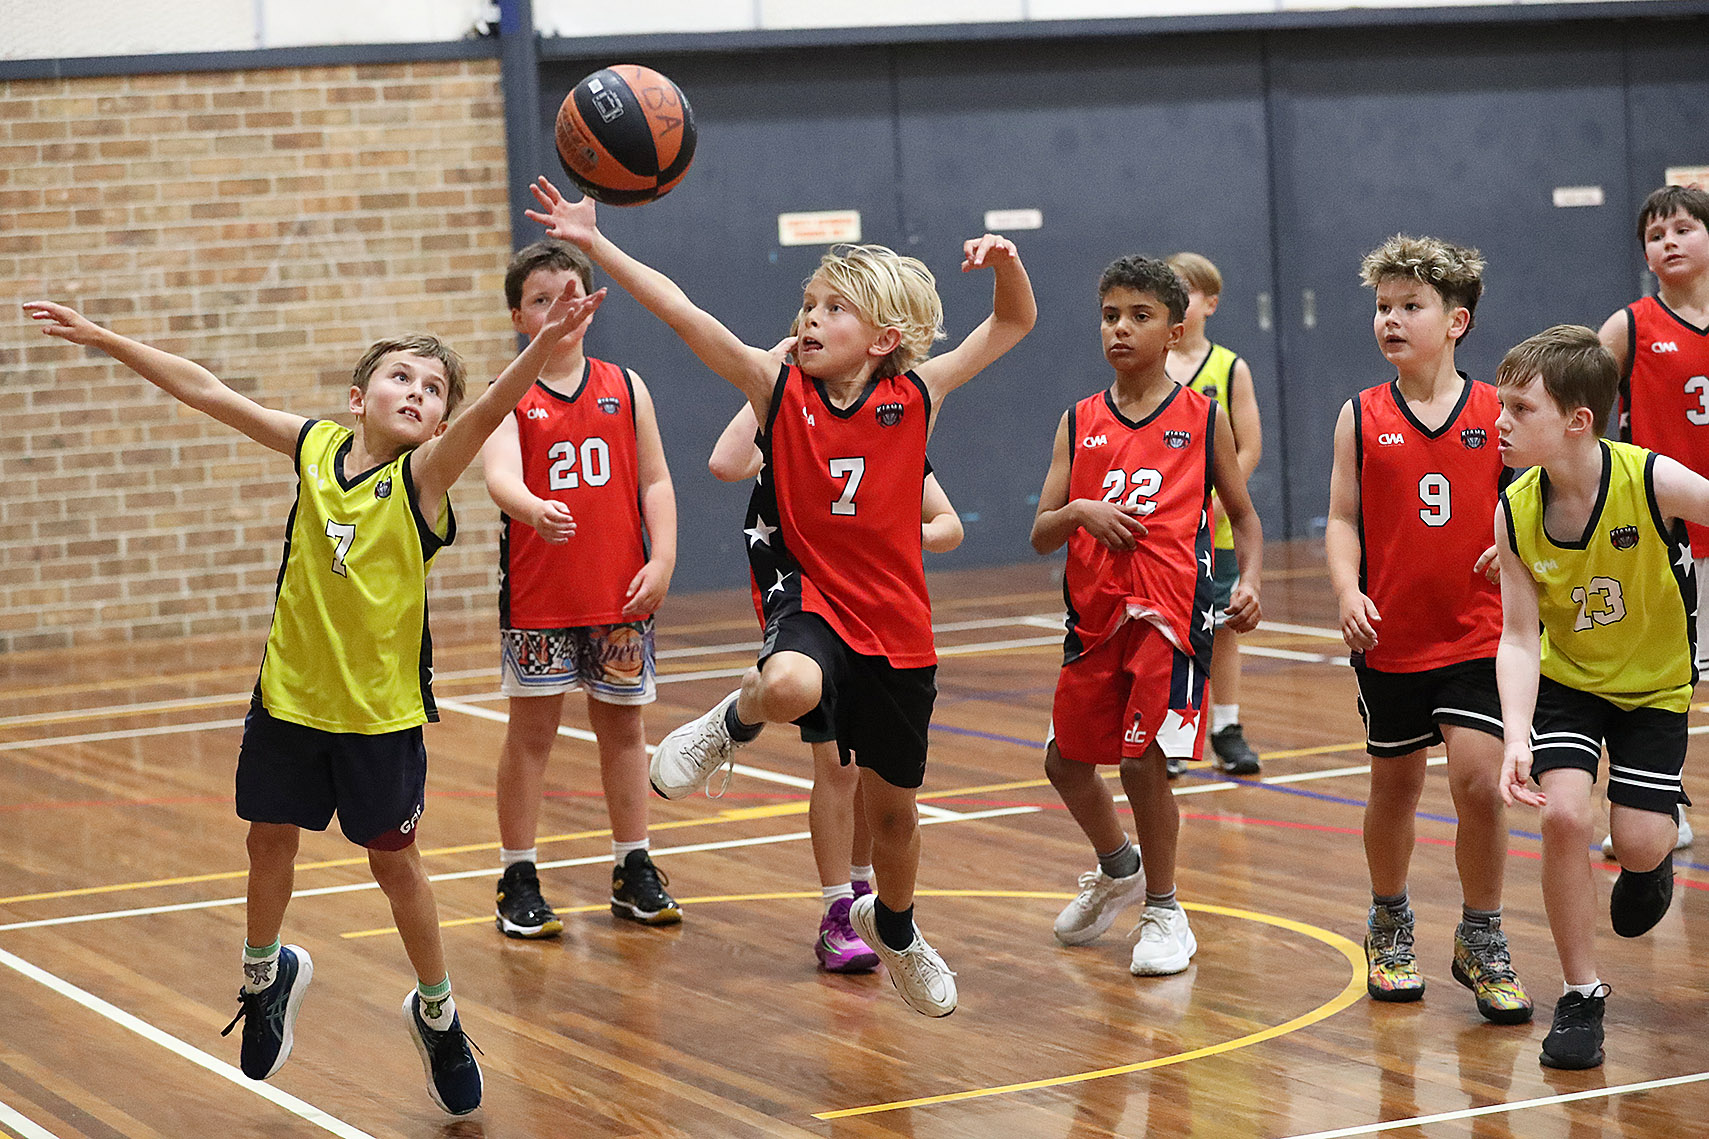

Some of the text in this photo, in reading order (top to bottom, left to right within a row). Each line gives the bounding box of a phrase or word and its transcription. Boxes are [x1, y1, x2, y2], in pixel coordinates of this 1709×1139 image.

[547, 437, 611, 491] 20
[1378, 433, 1405, 445] CWA
[828, 456, 866, 516] 7
[1101, 467, 1163, 516] 22
[1418, 472, 1452, 527] 9
[325, 518, 356, 578] 7
